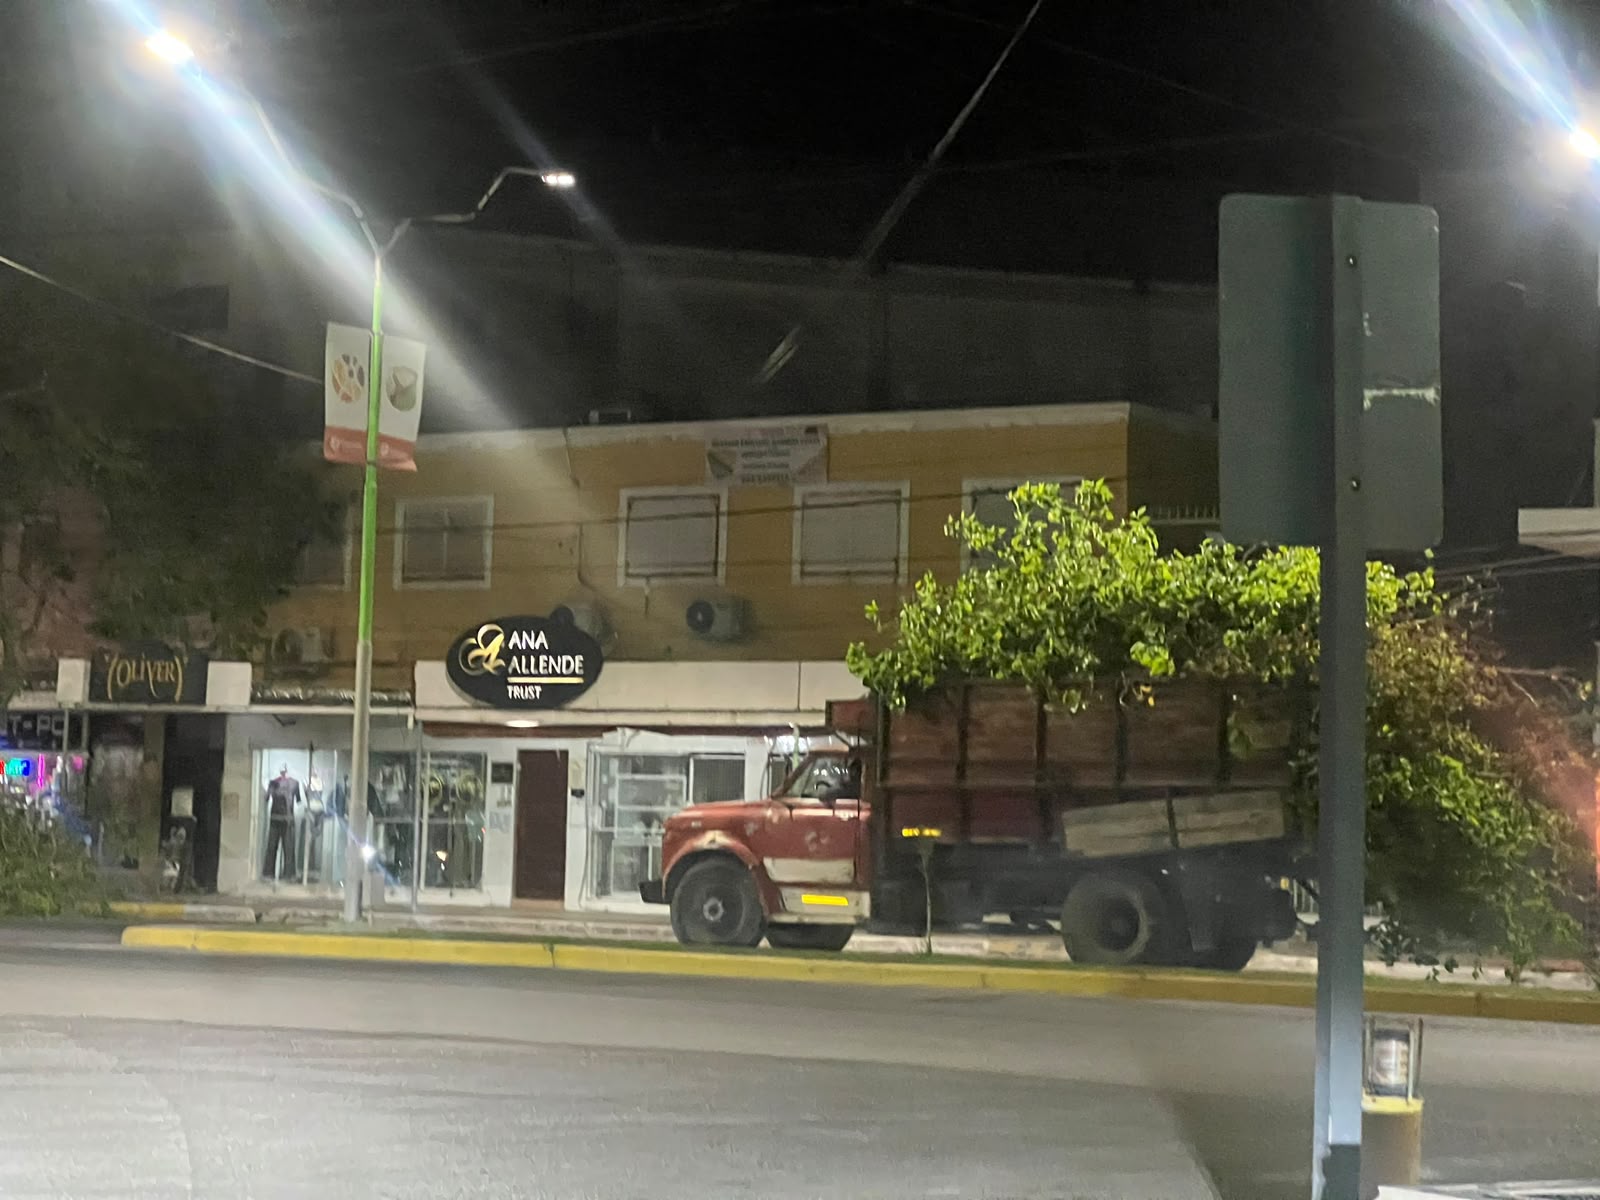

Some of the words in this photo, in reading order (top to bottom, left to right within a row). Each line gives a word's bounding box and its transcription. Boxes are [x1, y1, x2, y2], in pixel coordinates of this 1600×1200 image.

[508, 629, 549, 650] ANA
[508, 654, 584, 675] ALLENDE
[507, 684, 543, 700] TRUST
